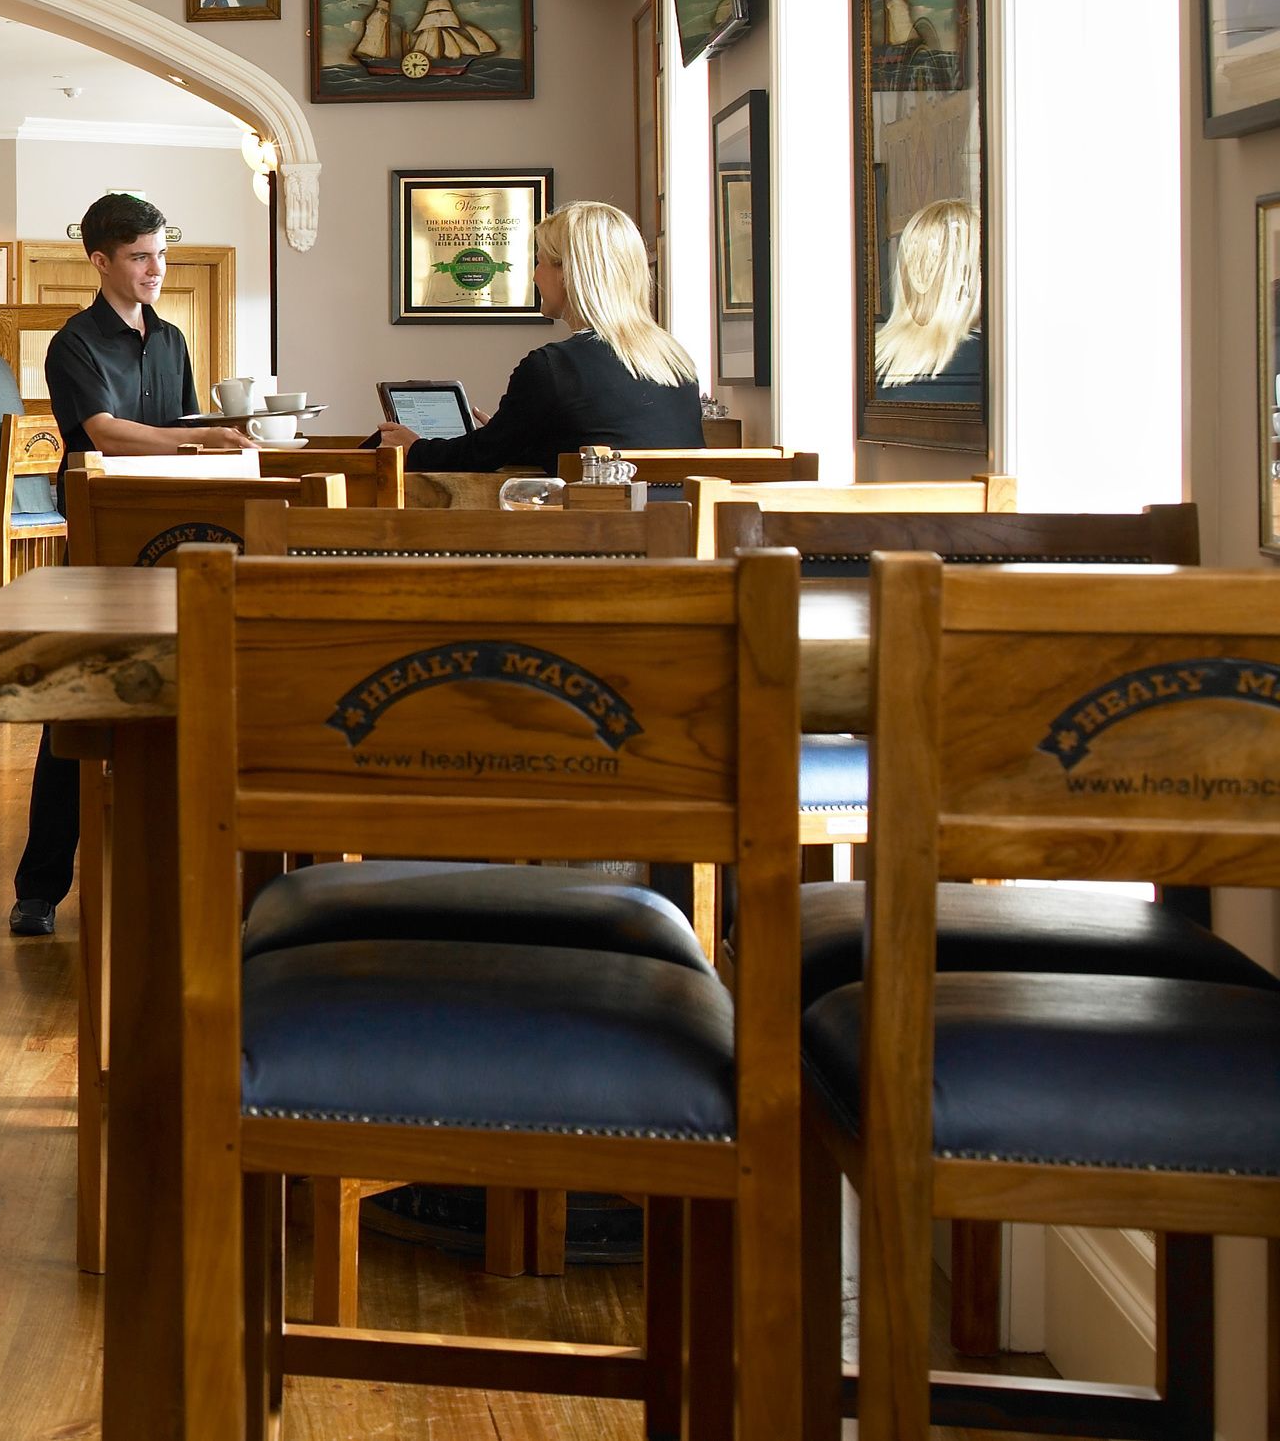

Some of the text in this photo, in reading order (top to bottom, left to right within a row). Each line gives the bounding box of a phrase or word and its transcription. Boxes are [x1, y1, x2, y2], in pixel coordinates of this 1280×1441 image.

[438, 233, 472, 241] HEALY
[147, 527, 196, 558] HEALY
[360, 650, 615, 717] HEALY MAC'S
[1072, 669, 1280, 733] HEALY M
